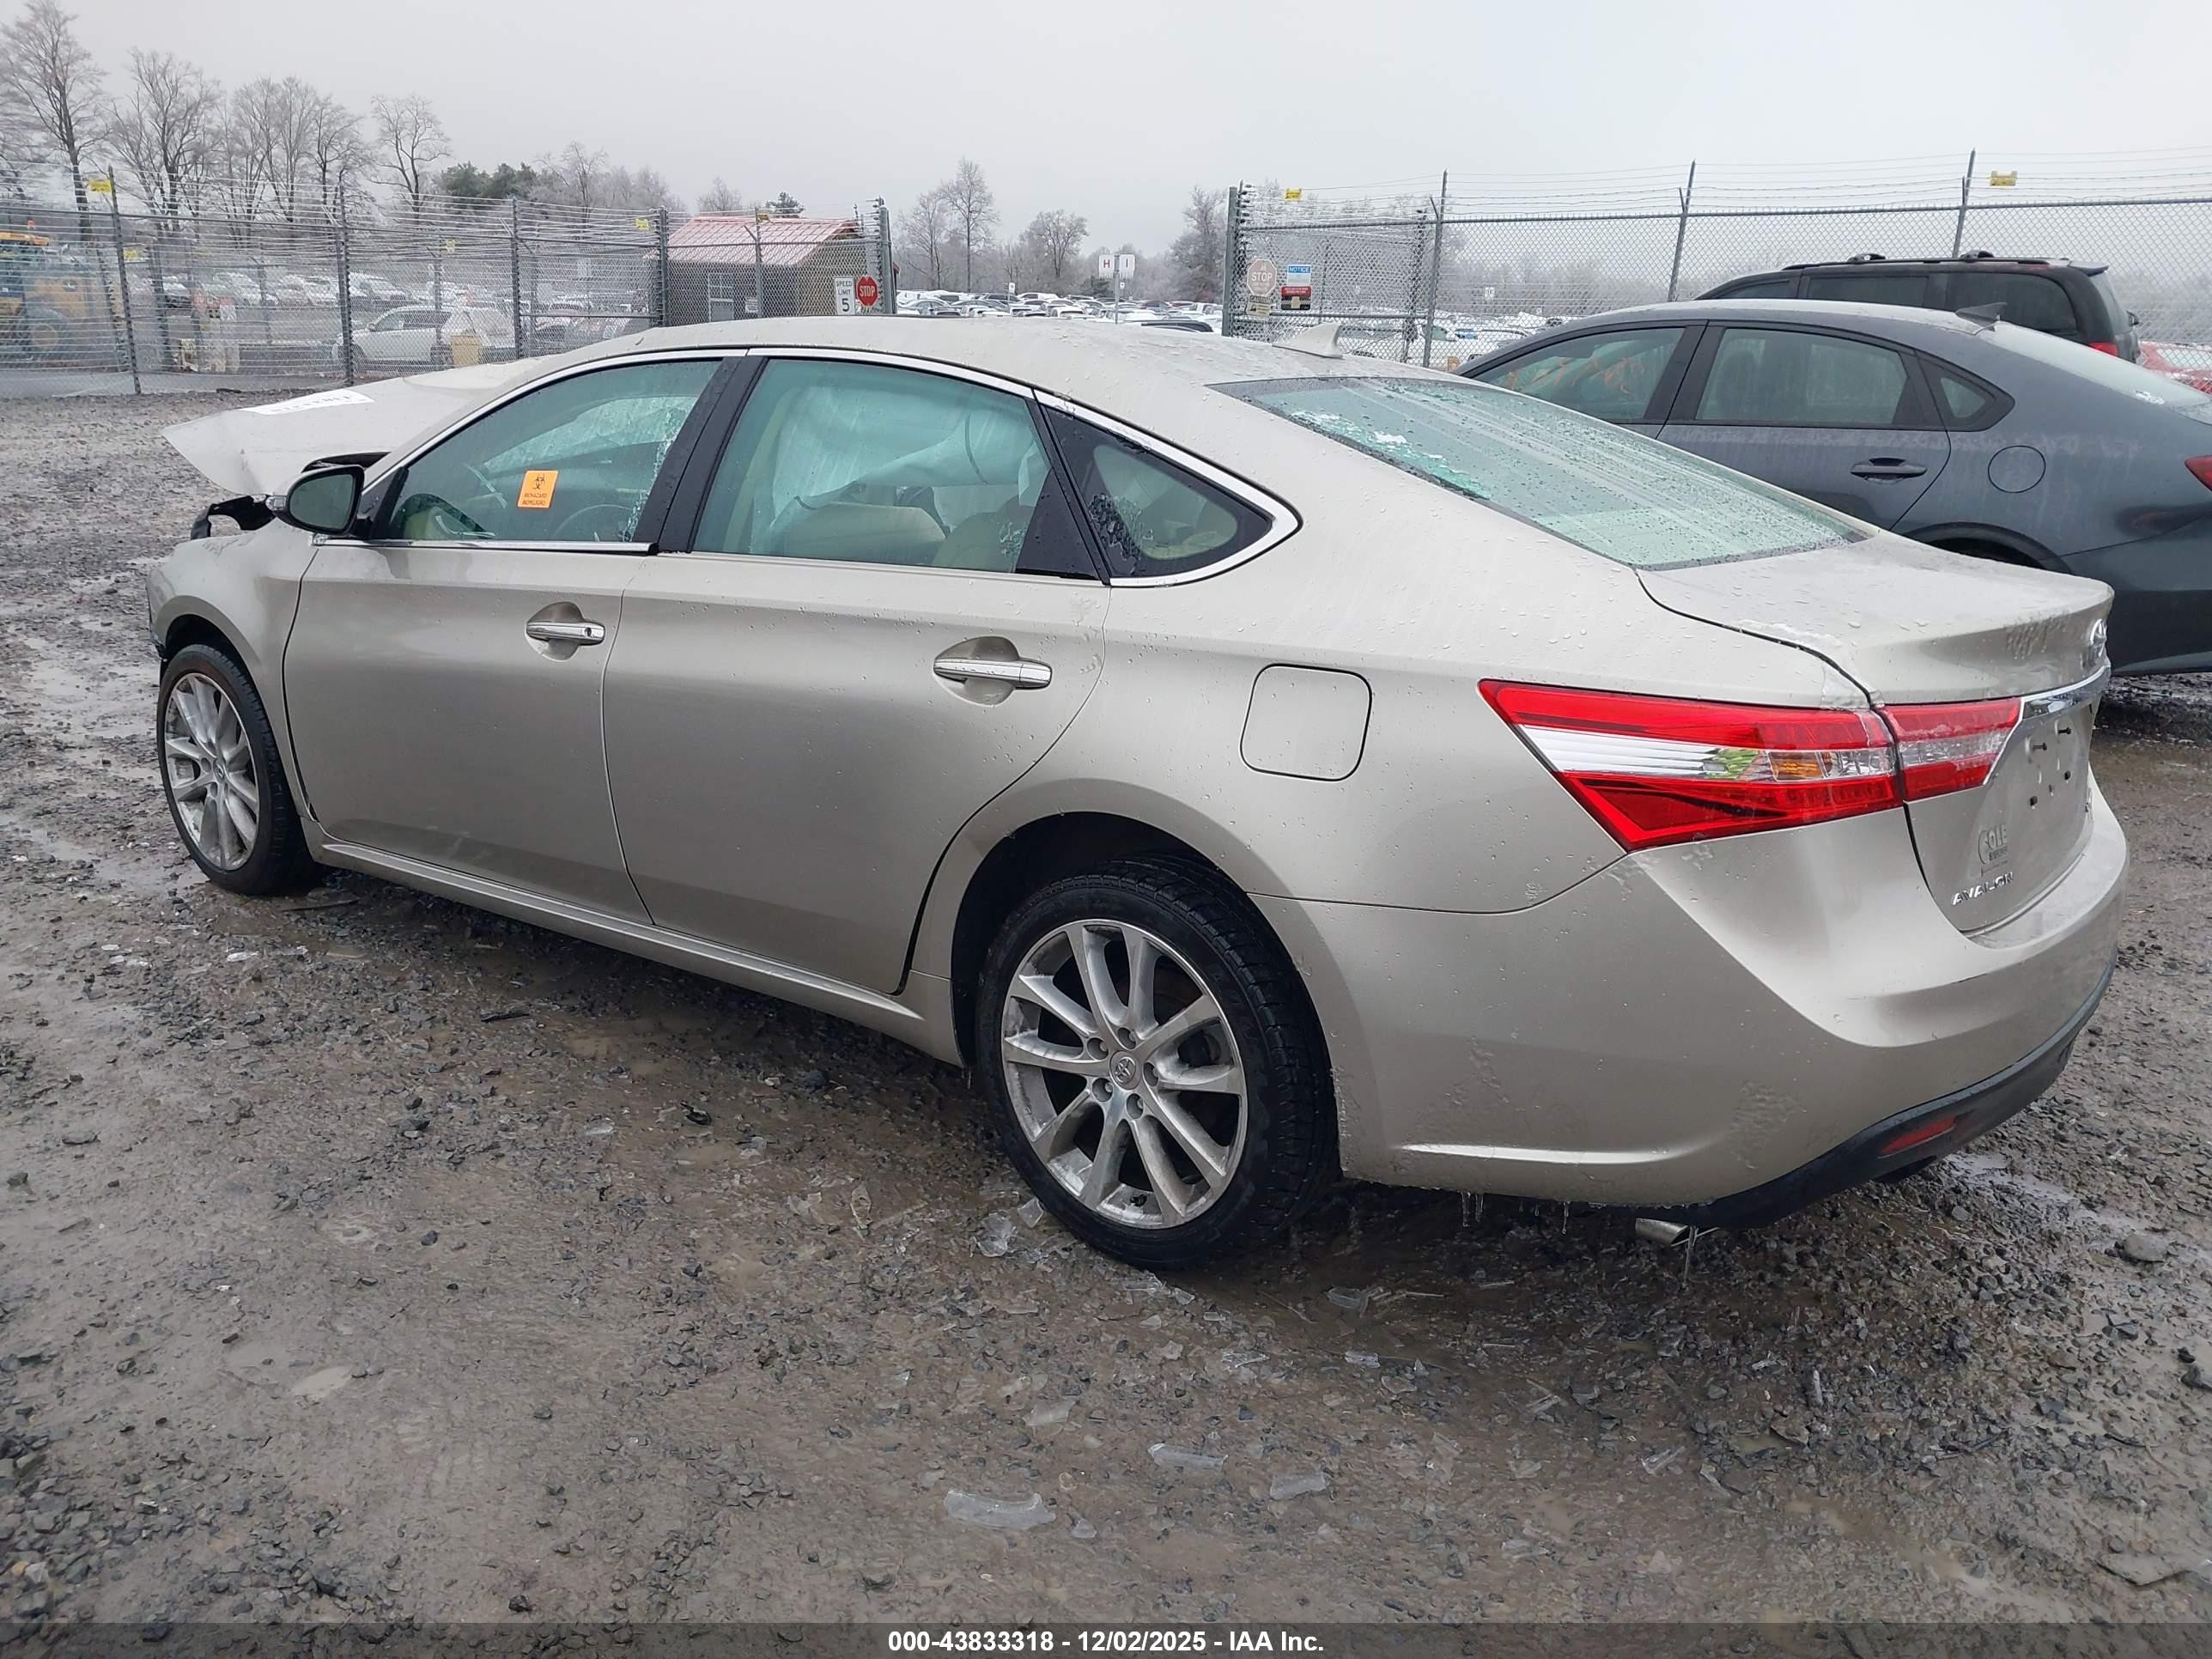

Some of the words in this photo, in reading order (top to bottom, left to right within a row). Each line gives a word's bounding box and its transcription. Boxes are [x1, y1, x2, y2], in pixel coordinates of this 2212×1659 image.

[1103, 258, 1110, 268] H
[1251, 271, 1273, 282] STOP
[859, 284, 876, 297] STOP
[842, 297, 850, 312] 5
[1951, 871, 2014, 906] AVALON
